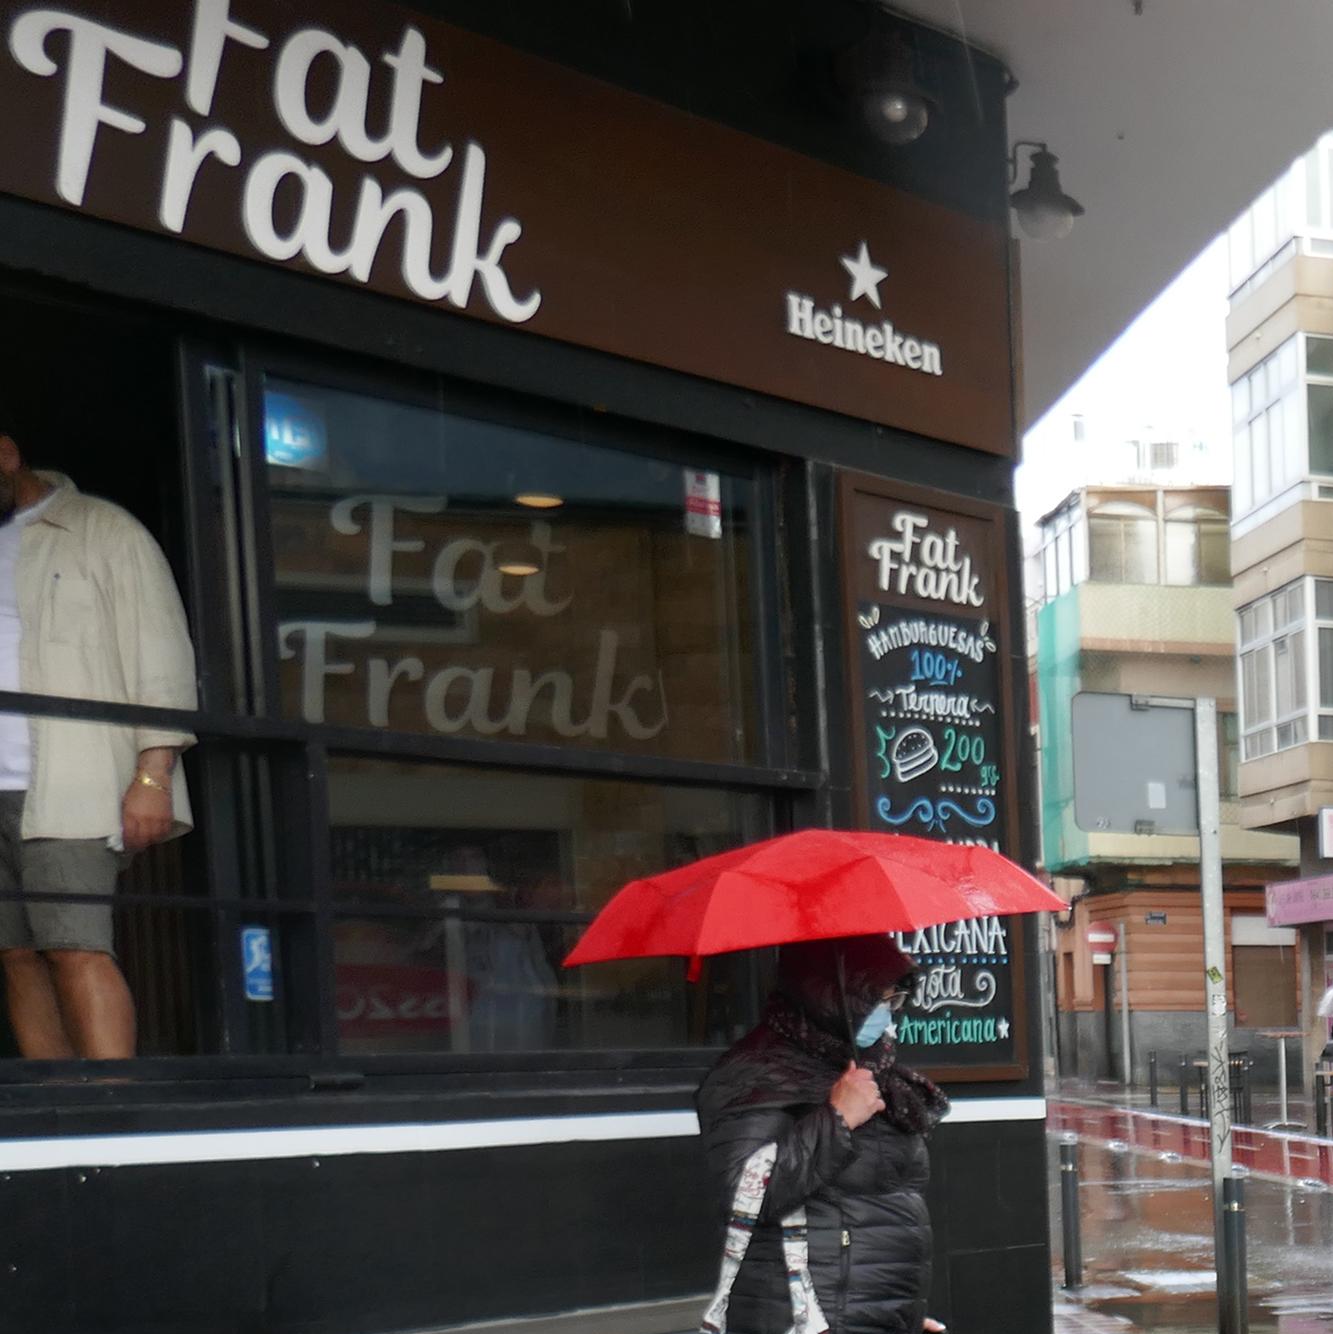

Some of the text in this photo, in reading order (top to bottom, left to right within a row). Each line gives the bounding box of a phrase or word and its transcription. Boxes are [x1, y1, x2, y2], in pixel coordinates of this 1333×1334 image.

[9, 9, 542, 323] Frank
[786, 291, 944, 376] Heineken
[330, 495, 575, 617] Fat
[892, 512, 962, 572] Fat
[868, 539, 984, 608] Frank
[867, 619, 985, 663] HAMBURGUESAS
[910, 650, 963, 685] 100%
[277, 619, 669, 740] Frank
[941, 728, 985, 771] 200
[889, 915, 1007, 955] EXICANA
[900, 1011, 997, 1045] Americana
